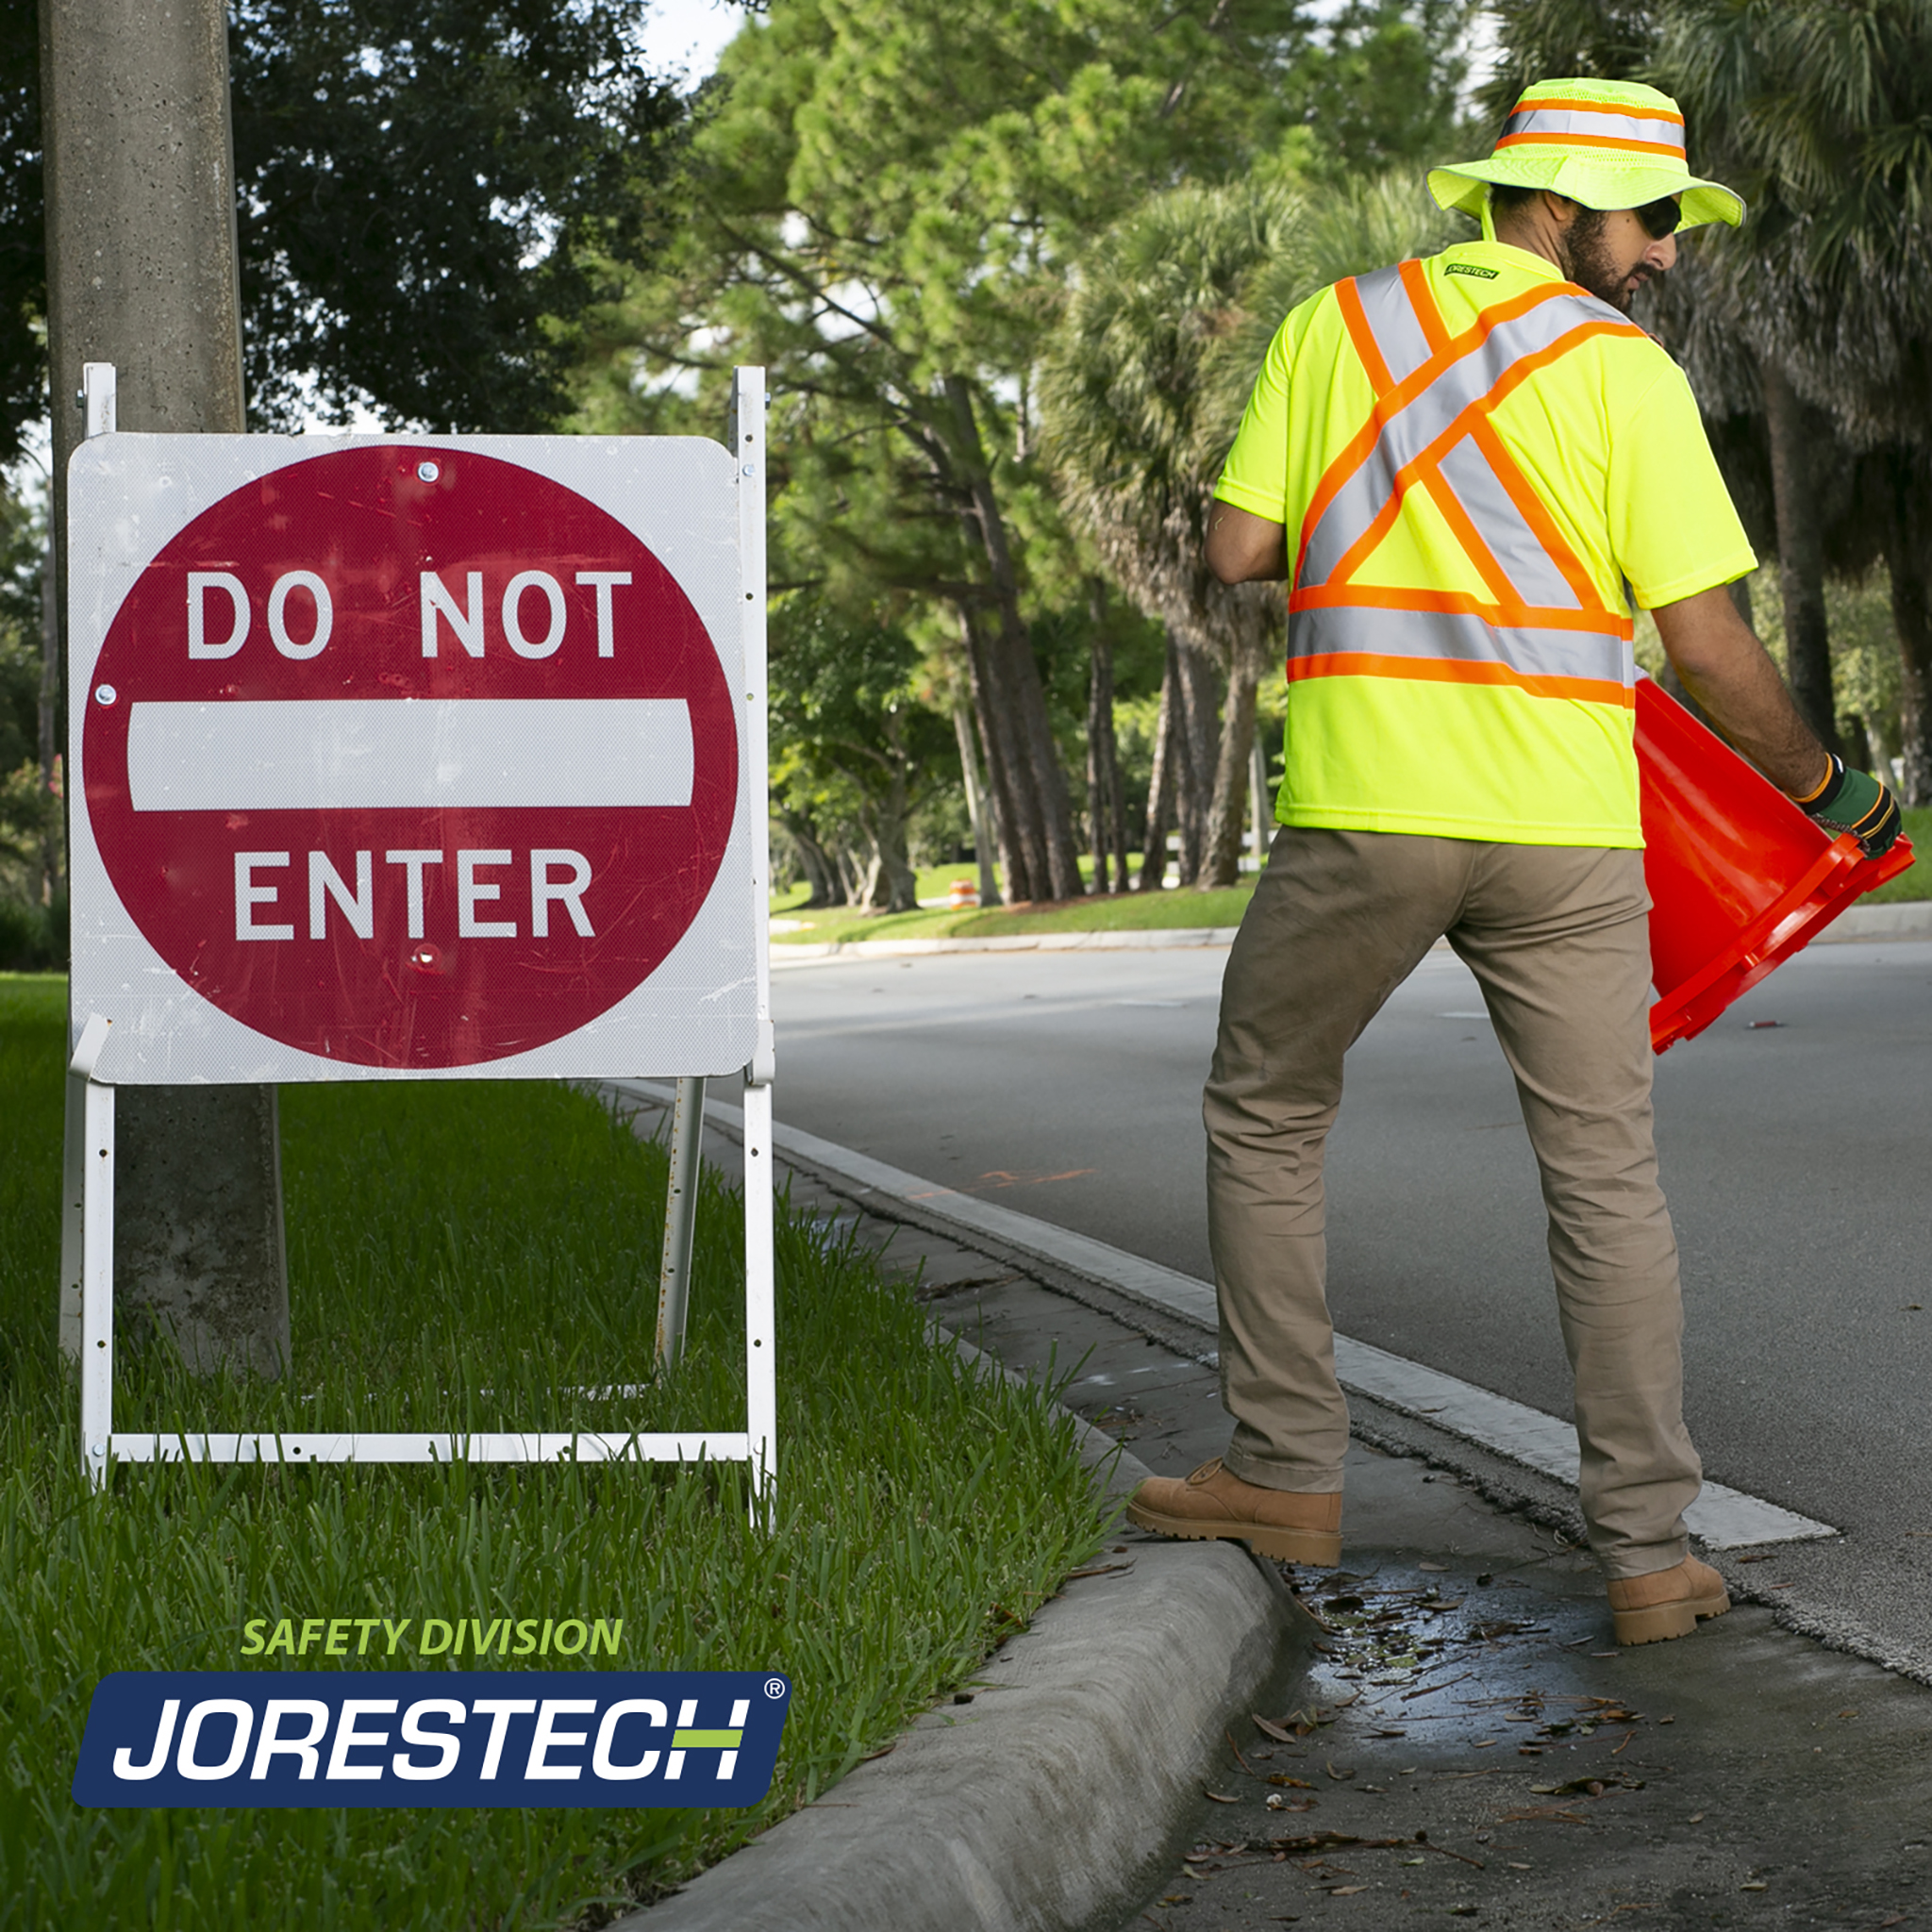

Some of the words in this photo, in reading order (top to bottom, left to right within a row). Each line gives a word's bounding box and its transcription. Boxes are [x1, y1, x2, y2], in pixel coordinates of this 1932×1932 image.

[186, 570, 334, 660] DO
[420, 569, 633, 659] NOT
[234, 848, 596, 941] ENTER
